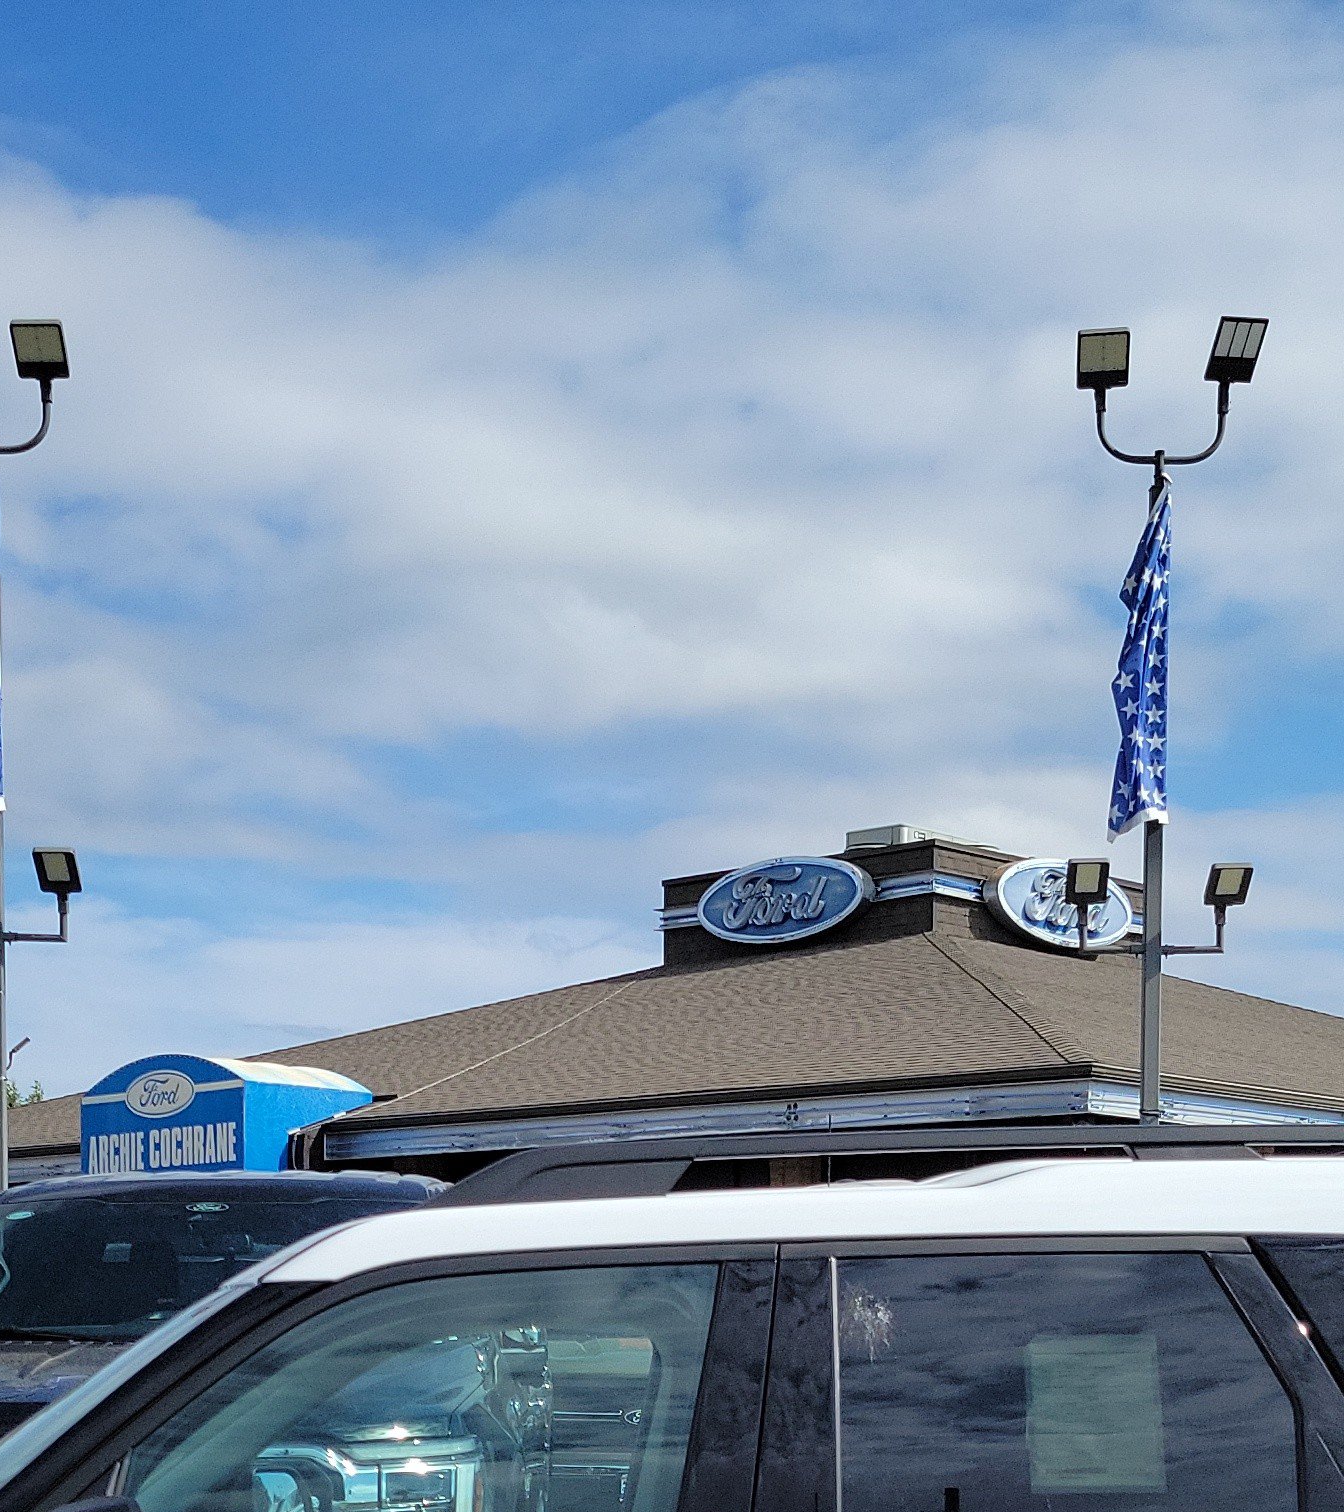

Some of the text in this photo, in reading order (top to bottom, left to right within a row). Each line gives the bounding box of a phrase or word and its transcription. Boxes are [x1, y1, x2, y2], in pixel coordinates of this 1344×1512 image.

[722, 867, 828, 929] Ford
[140, 1078, 179, 1107] Ford
[88, 1121, 237, 1174] ARCHIE COCHRANE
